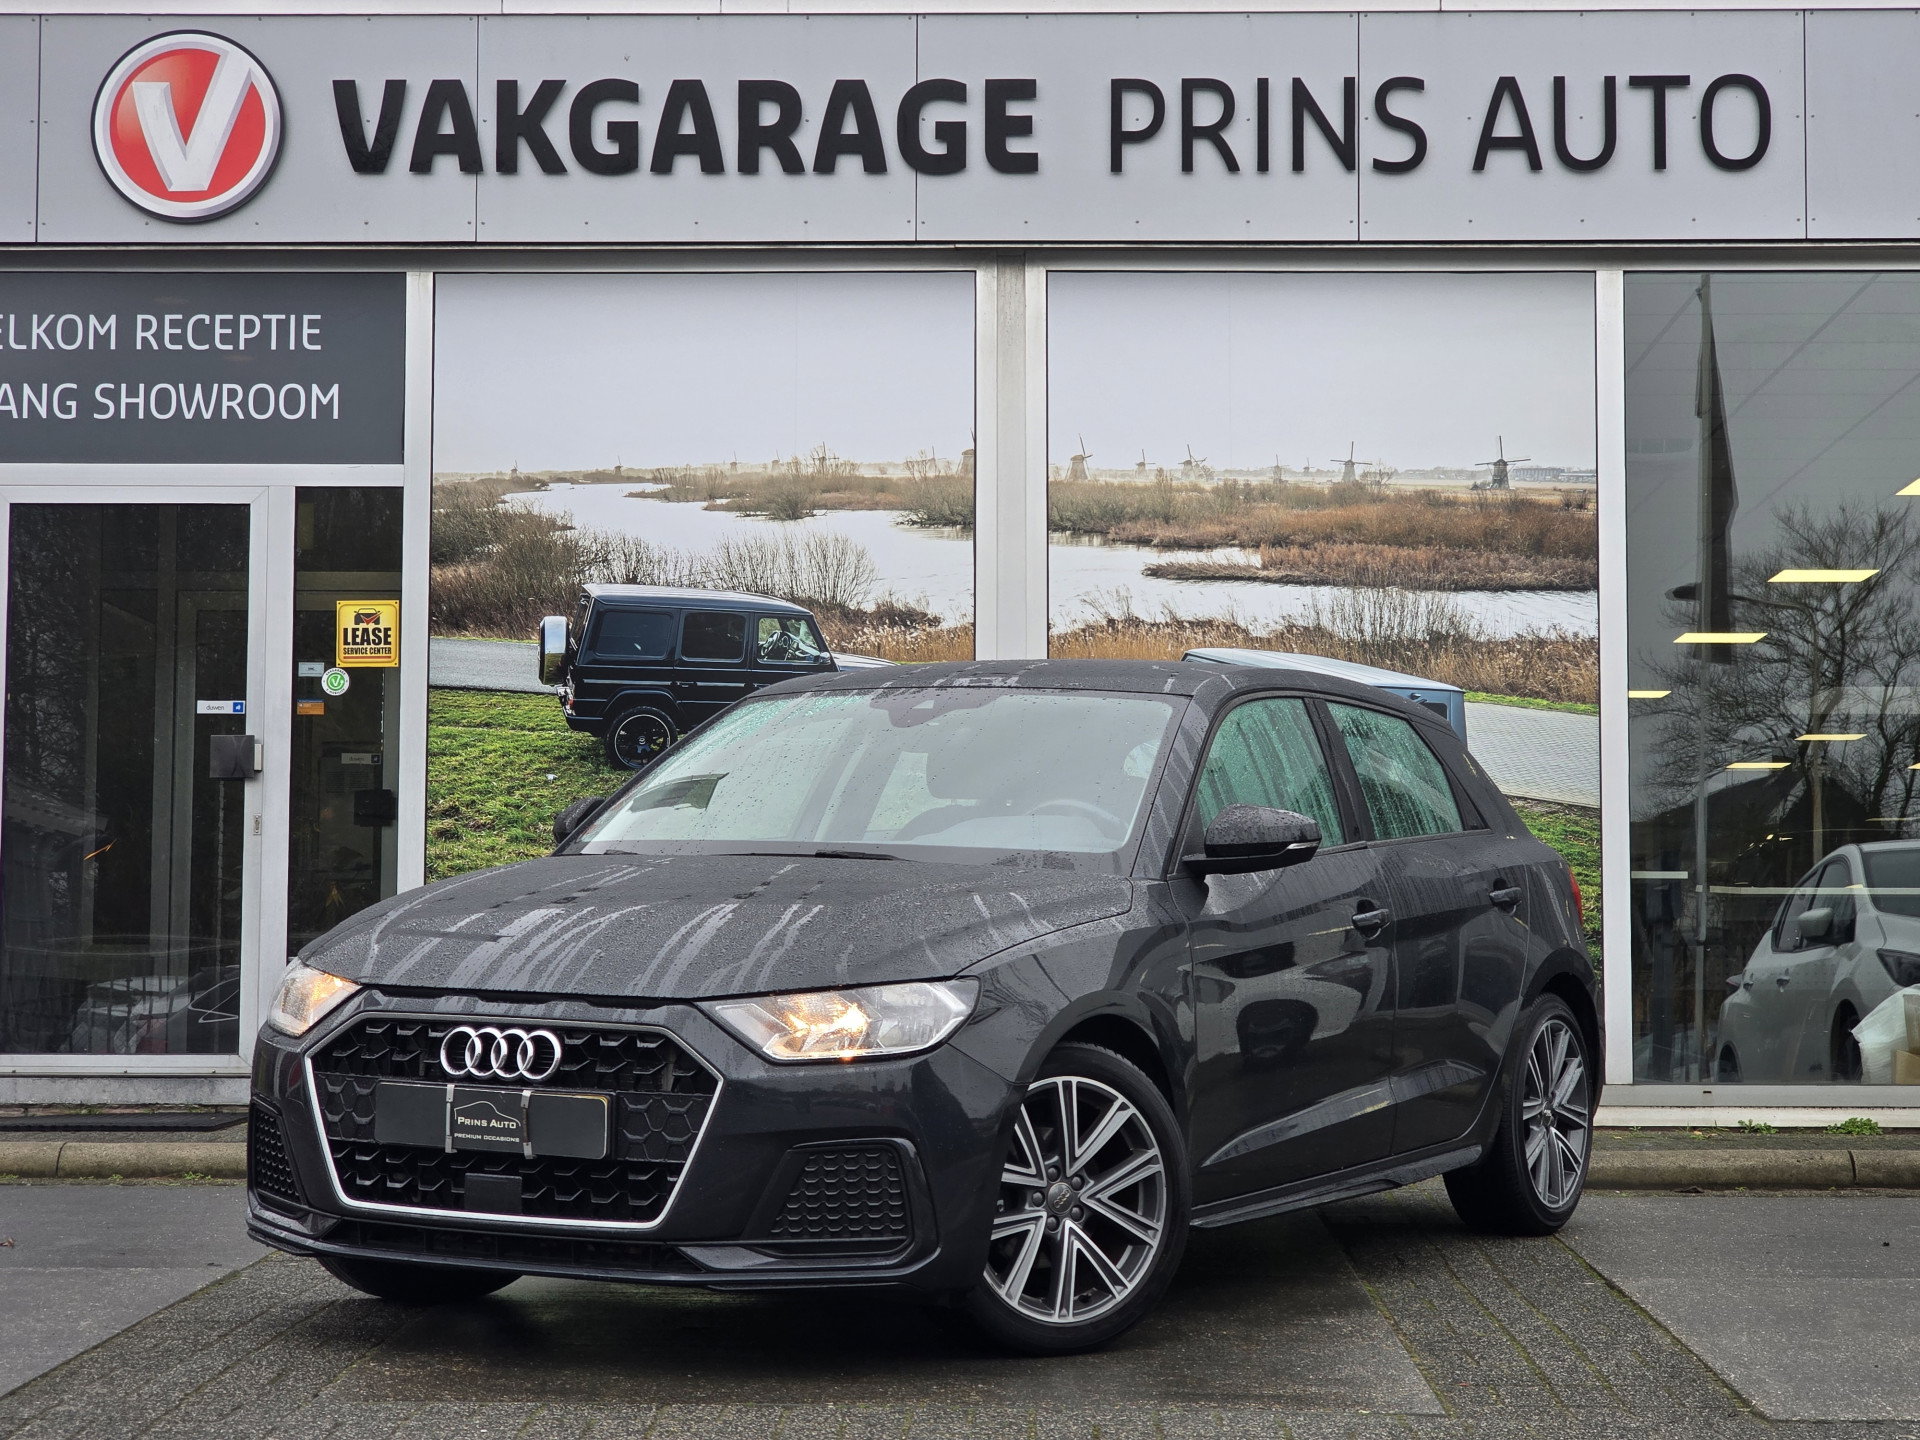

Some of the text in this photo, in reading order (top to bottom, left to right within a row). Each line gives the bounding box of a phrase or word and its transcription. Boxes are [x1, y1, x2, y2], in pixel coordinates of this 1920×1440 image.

[332, 74, 1772, 176] VAKGARAGE PRINS AUTO
[136, 314, 322, 351] RECEPTIE
[93, 383, 339, 420] SHOWROOM
[343, 627, 392, 646] LEASE
[343, 647, 392, 655] SERVICE CENTER
[454, 1132, 520, 1143] PREMIUM OCCASIONS
